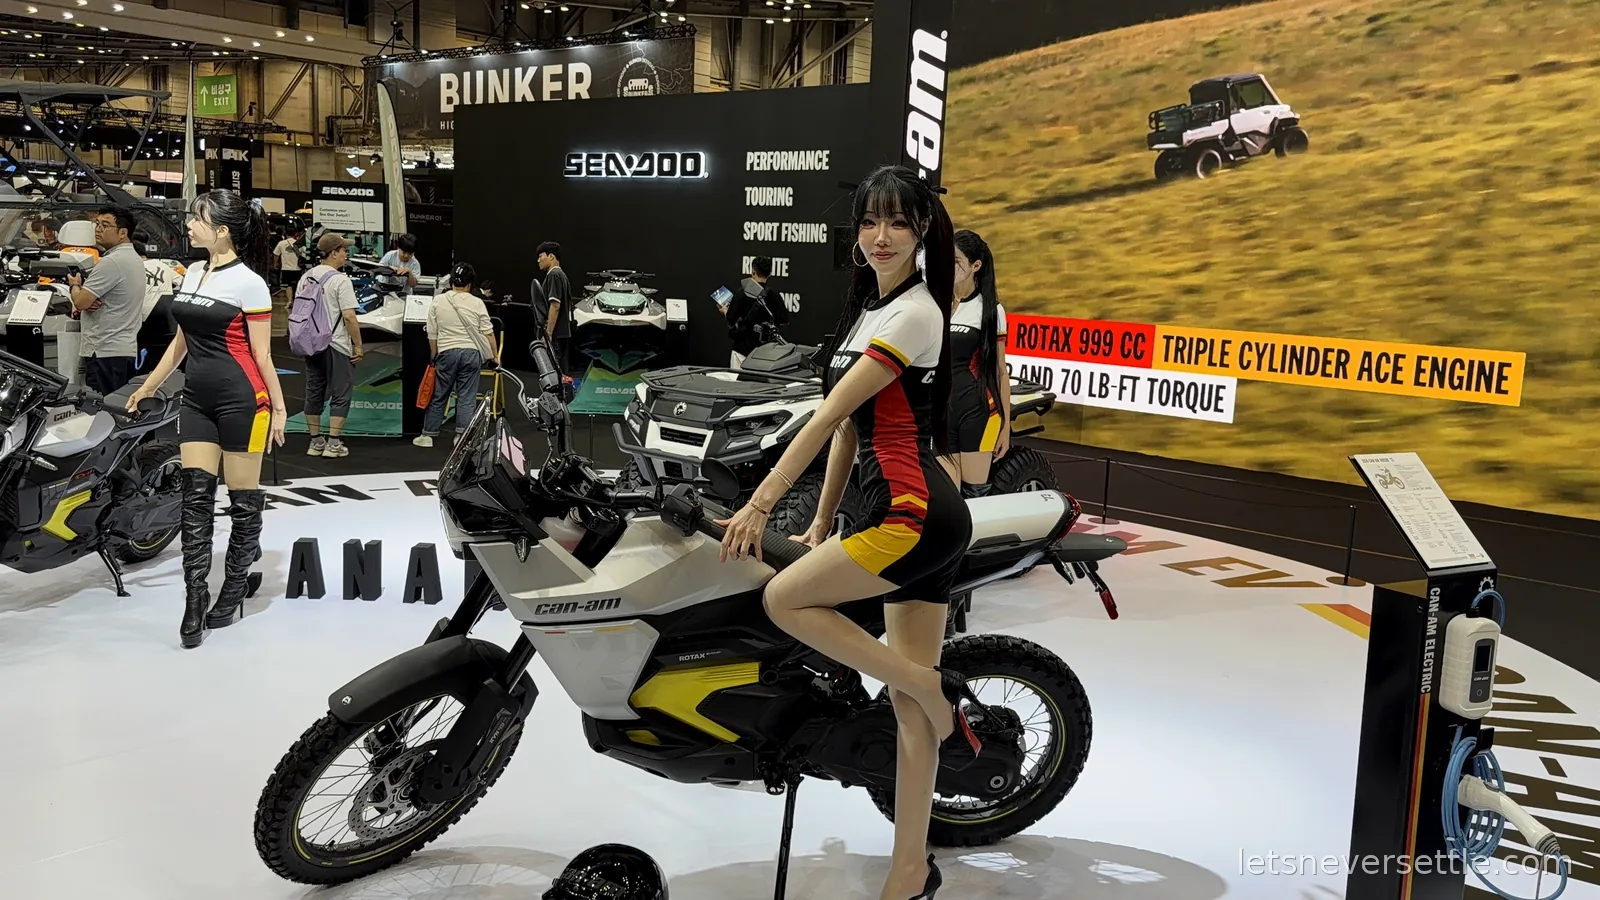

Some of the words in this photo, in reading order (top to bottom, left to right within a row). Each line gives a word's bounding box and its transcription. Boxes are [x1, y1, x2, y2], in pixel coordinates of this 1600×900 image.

[211, 83, 232, 95] 비상구
[440, 62, 592, 113] BUNKER
[213, 96, 230, 107] EXIT
[746, 150, 830, 171] PERFORMANCE
[745, 186, 794, 207] TOURING
[743, 221, 779, 242] SPORT
[781, 222, 828, 243] FISHING
[1016, 323, 1073, 353] ROTAX
[1079, 328, 1114, 357] 999
[1120, 331, 1146, 360] CC
[1162, 334, 1232, 368] TRIPLE
[1238, 340, 1350, 379] CYLINDER
[1356, 350, 1406, 386] ACE
[1413, 355, 1512, 395] ENGINE
[1018, 364, 1053, 392] AND
[1061, 368, 1082, 396] 70
[1088, 371, 1140, 404] LB-FT
[1147, 377, 1226, 414] TORQUE
[1160, 556, 1330, 589] EV
[534, 597, 622, 616] can-am
[1426, 587, 1441, 636] CAN-AM
[679, 652, 706, 662] ROTAX
[1420, 638, 1436, 693] ELECTRIC
